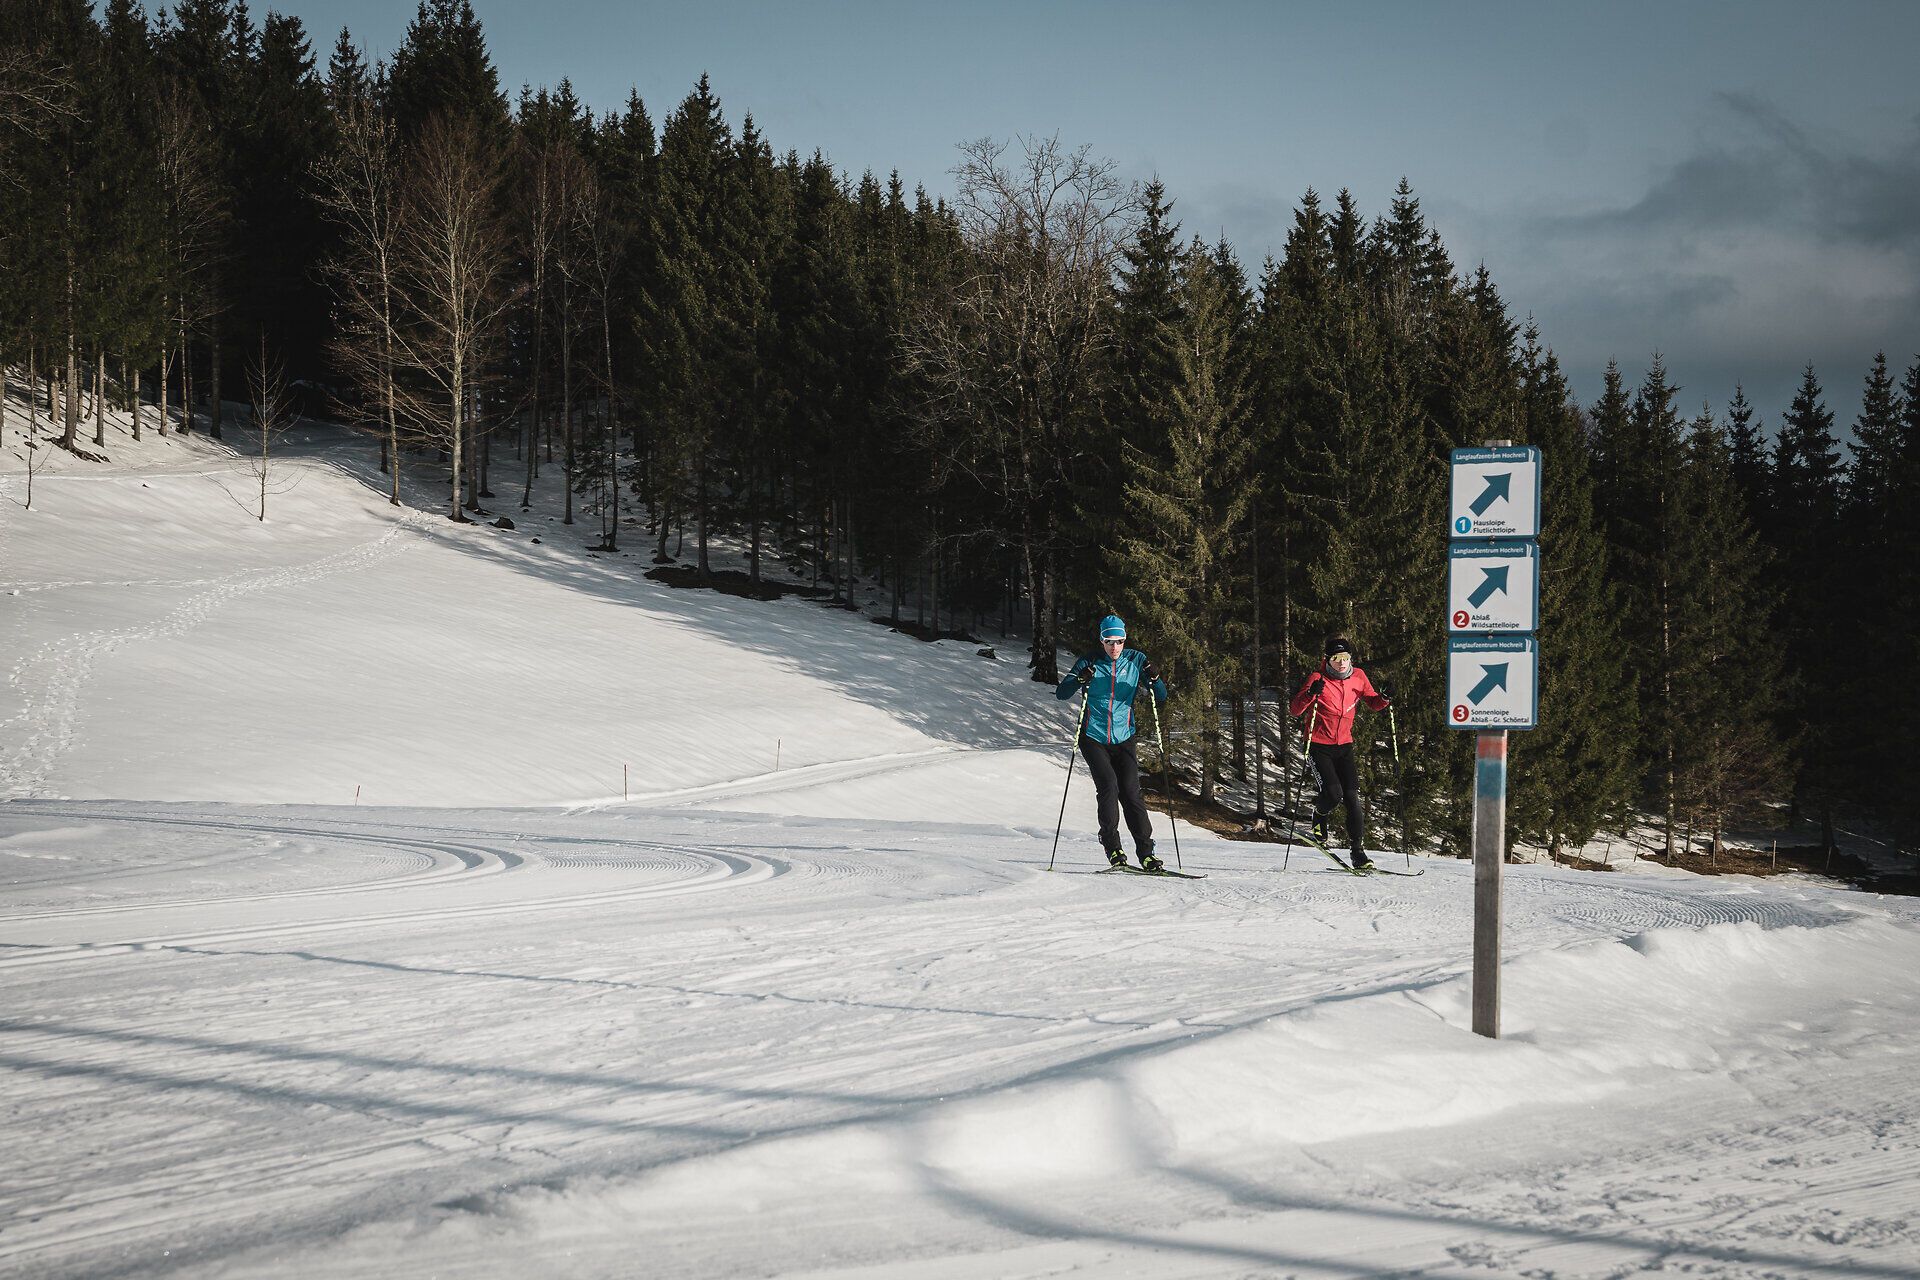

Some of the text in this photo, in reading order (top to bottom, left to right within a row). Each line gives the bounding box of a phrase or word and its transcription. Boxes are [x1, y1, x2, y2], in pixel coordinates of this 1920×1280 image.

[1460, 519, 1466, 531] 1
[1456, 613, 1466, 626] 2
[1456, 707, 1465, 720] 3
